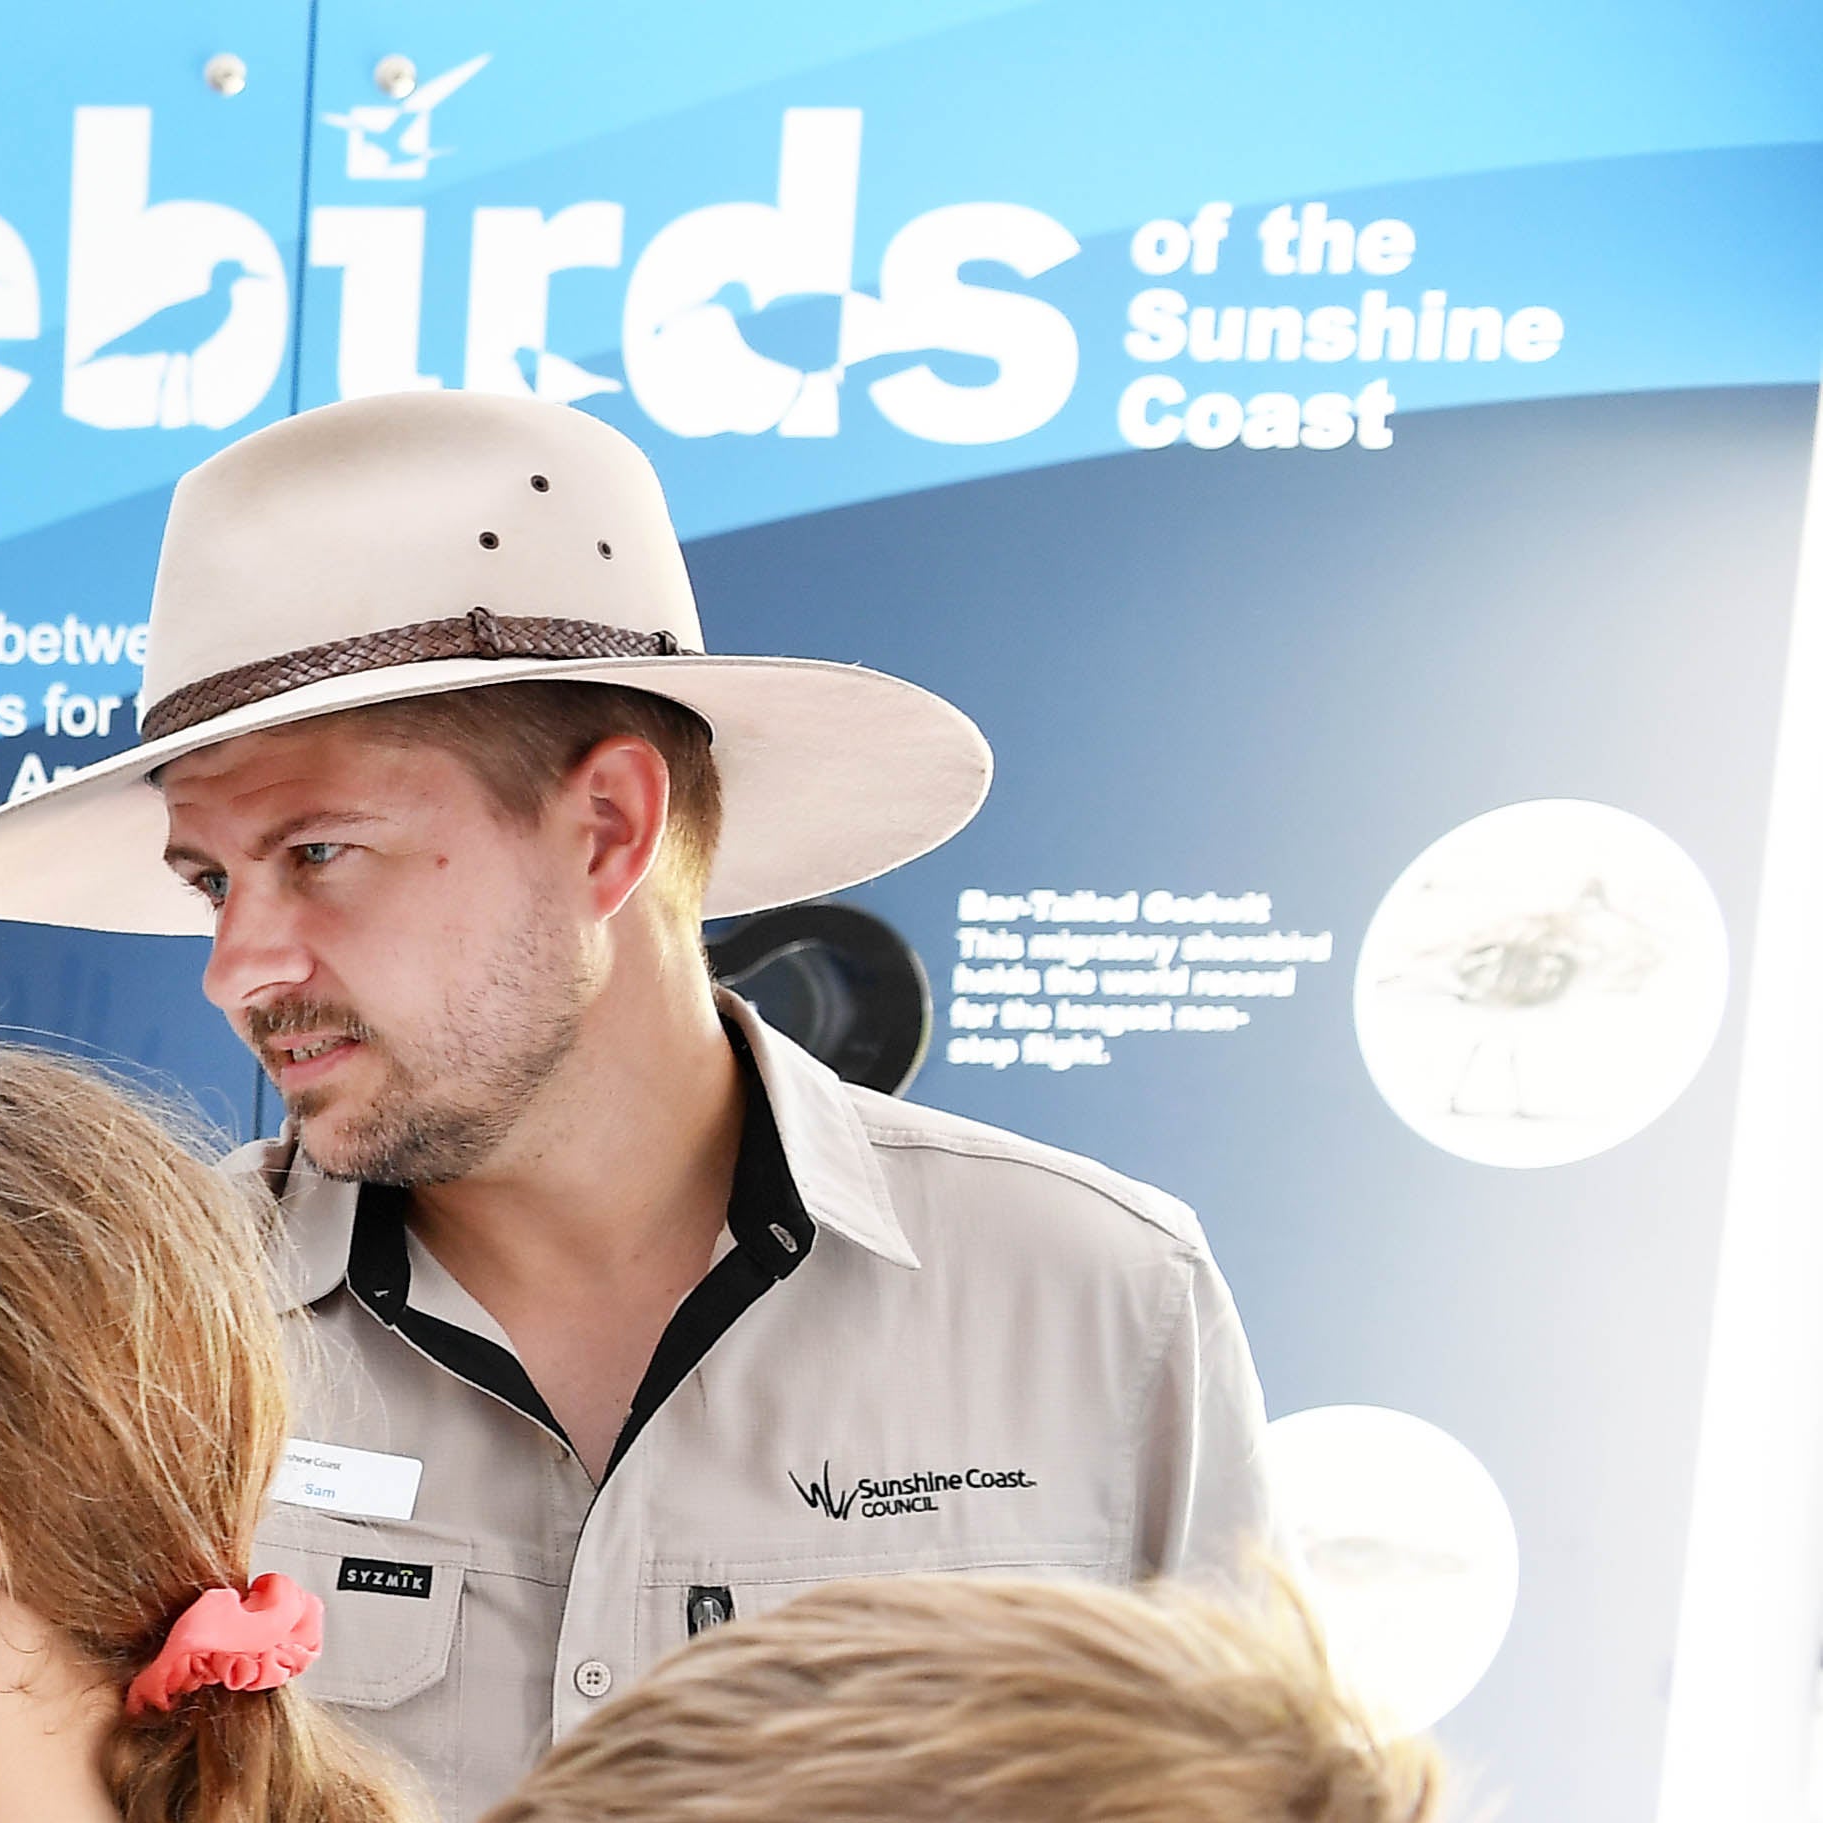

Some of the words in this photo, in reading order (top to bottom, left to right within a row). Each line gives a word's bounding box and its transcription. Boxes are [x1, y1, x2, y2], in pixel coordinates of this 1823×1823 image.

[1129, 199, 1235, 276] of
[1258, 201, 1416, 276] the
[1123, 288, 1565, 364] Sunshine
[1117, 375, 1396, 450] Coast
[43, 682, 122, 738] for
[304, 1482, 337, 1500] Sam
[857, 1471, 963, 1500] Sunshine
[965, 1468, 1028, 1490] Coast
[861, 1496, 939, 1519] COUNCIL
